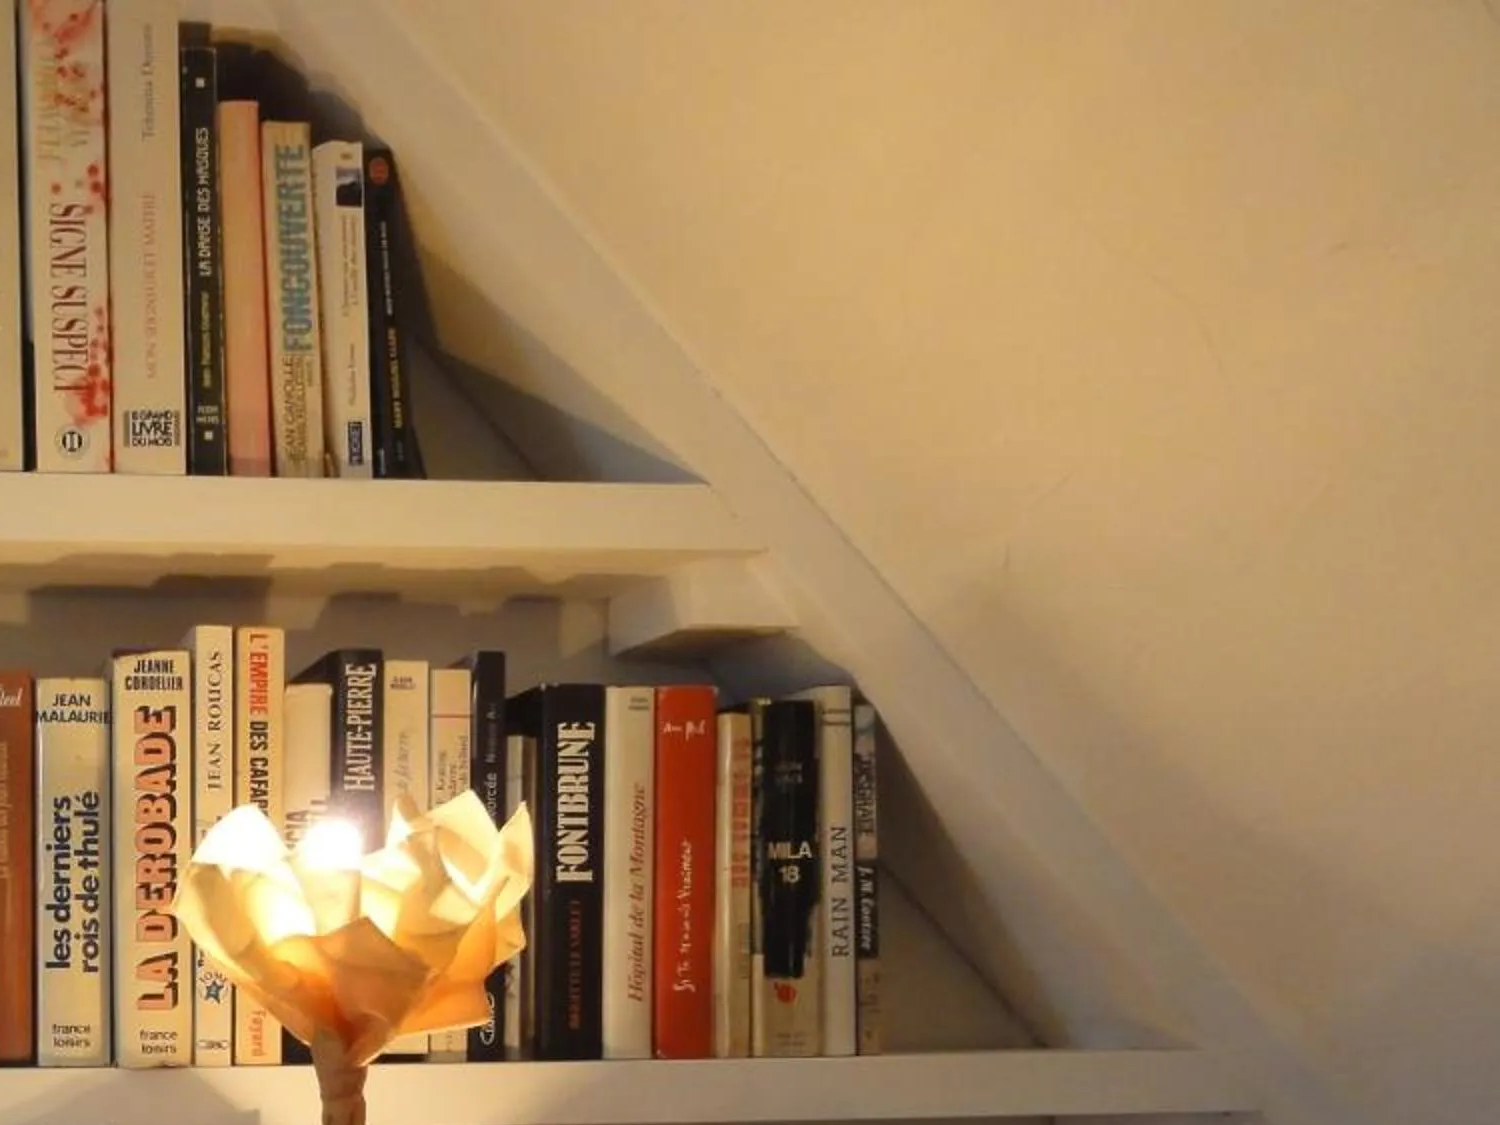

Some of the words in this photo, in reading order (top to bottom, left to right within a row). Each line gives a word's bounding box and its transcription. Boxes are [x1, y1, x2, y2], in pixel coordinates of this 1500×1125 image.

[197, 187, 211, 212] DES
[48, 202, 88, 278] SIGNE
[274, 142, 313, 352] FONCOUVERTE
[51, 285, 91, 392] SUSPECT
[52, 692, 91, 706] JEAN
[206, 651, 222, 732] ROUCAS
[249, 633, 270, 716] L'EMPIRE
[249, 721, 269, 758] DES
[343, 663, 378, 791] HAUTE-PIERRE
[207, 741, 222, 790] JEAN
[71, 790, 99, 870] thulé
[133, 704, 178, 942] DEROBADE
[555, 721, 596, 883] FONTBRUNE
[628, 782, 651, 878] Montagne
[45, 797, 72, 925] derniers
[779, 866, 800, 883] 18
[830, 825, 848, 884] MAN
[74, 876, 99, 913] de
[626, 884, 644, 901] la
[627, 908, 645, 928] de
[46, 930, 73, 969] les
[77, 917, 100, 973] rois
[832, 896, 851, 958] RAIN
[136, 951, 178, 1011] LA
[627, 933, 648, 1003] Hôpital
